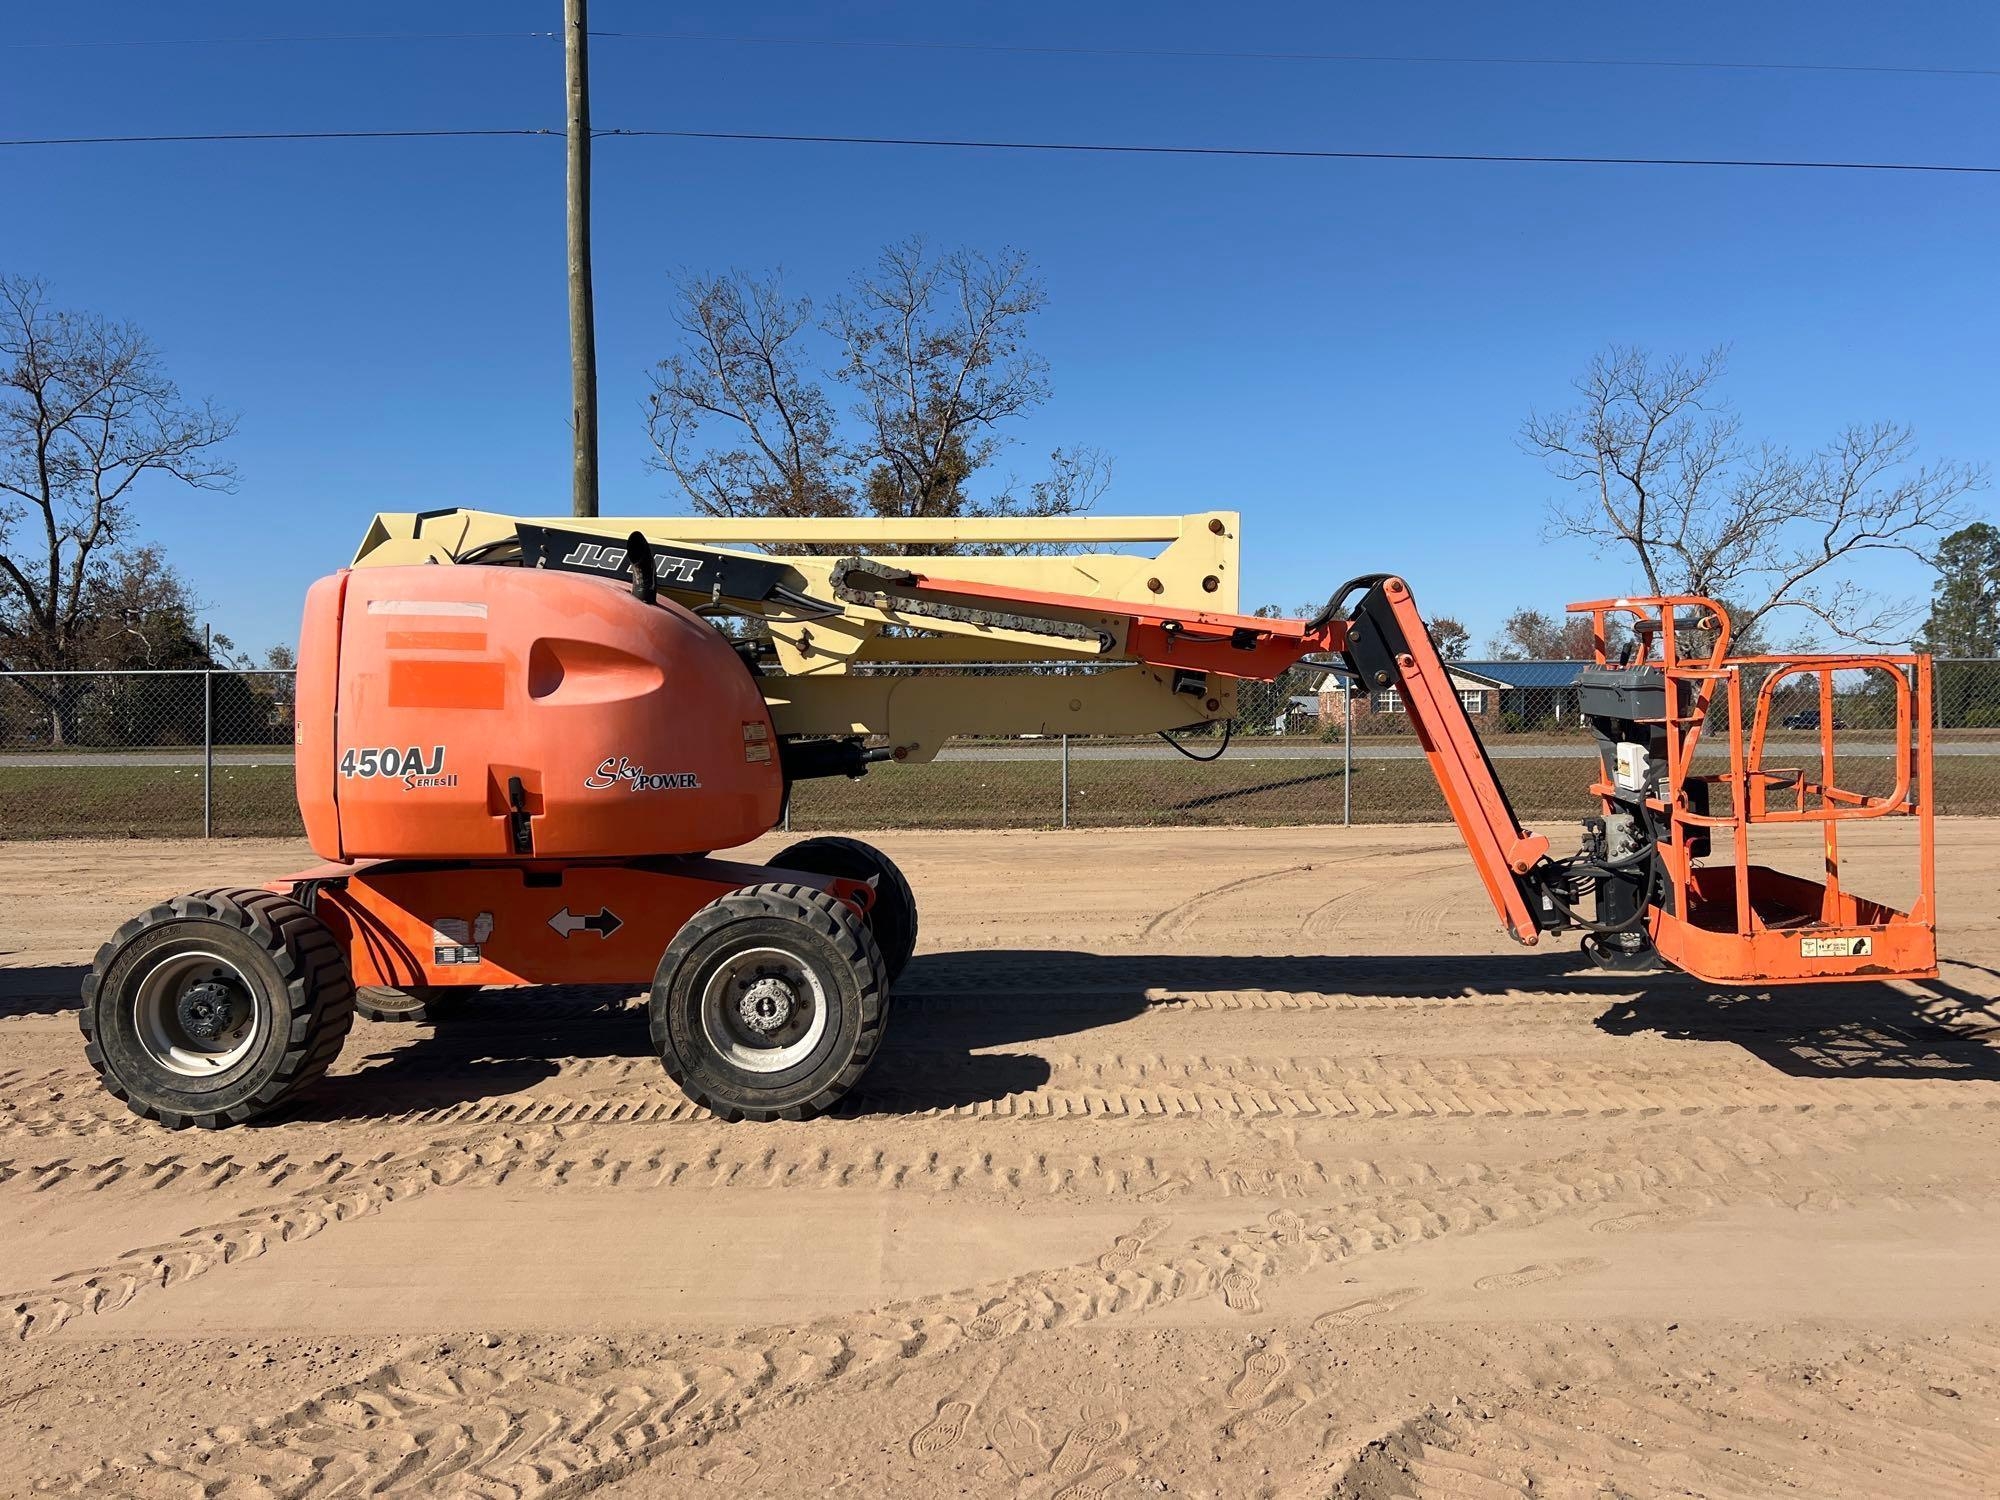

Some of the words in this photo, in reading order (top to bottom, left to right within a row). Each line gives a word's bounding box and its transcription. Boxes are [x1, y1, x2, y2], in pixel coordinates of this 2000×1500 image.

[562, 542, 628, 571] JLG
[627, 553, 704, 582] IFT
[340, 746, 445, 779] 450AJ
[584, 757, 643, 792] Sky
[638, 773, 698, 790] POWER
